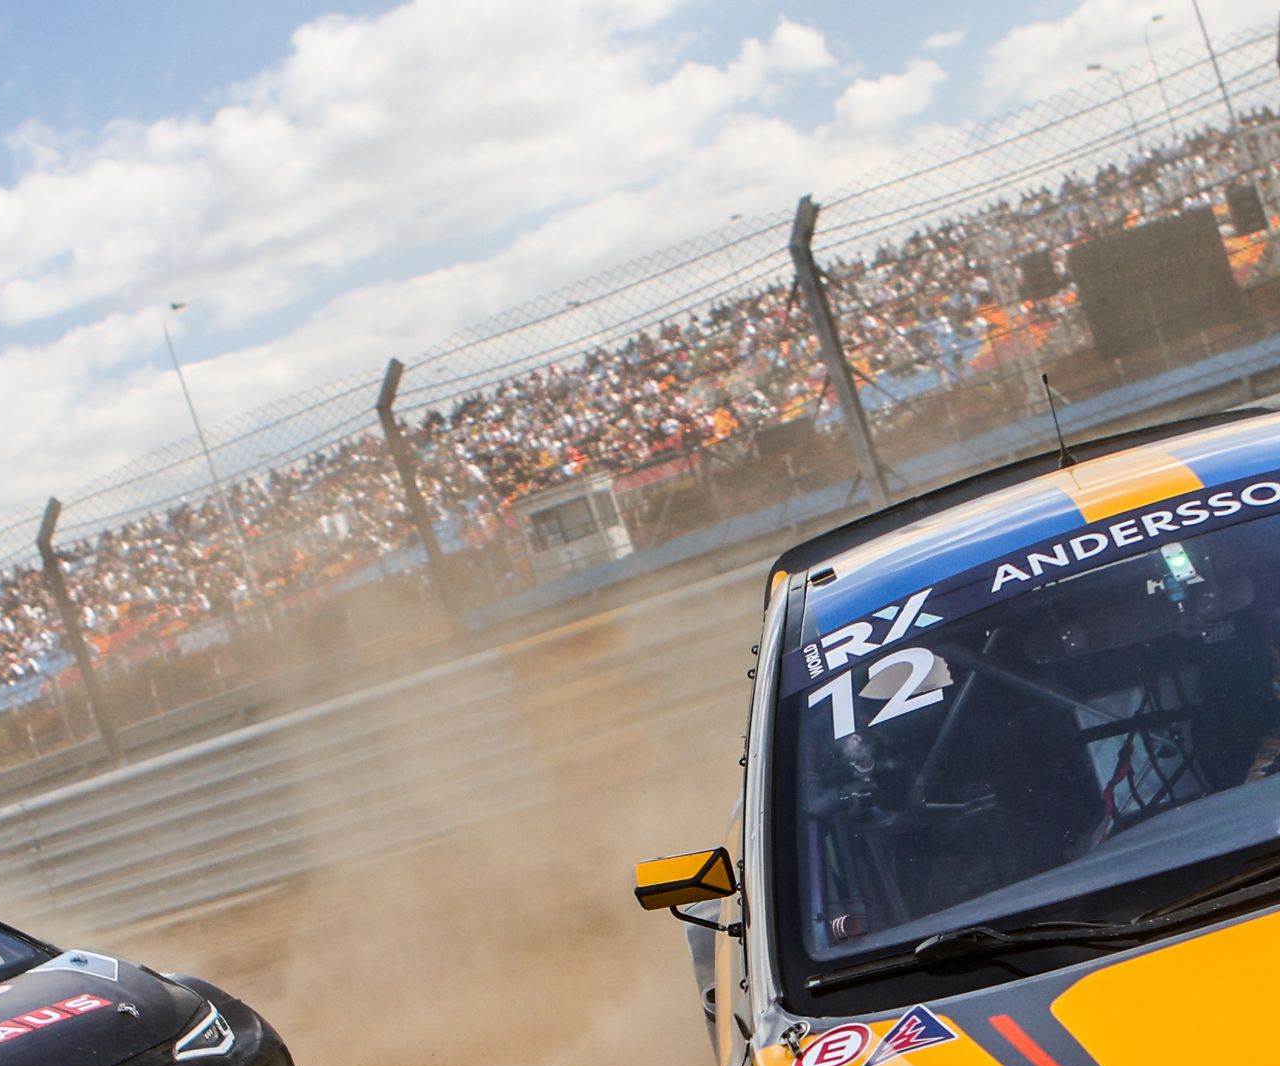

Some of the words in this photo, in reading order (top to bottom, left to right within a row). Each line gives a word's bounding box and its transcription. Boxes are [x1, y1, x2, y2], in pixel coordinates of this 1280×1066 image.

[803, 642, 825, 680] WORLD
[821, 587, 945, 671] RX
[807, 647, 944, 741] 12
